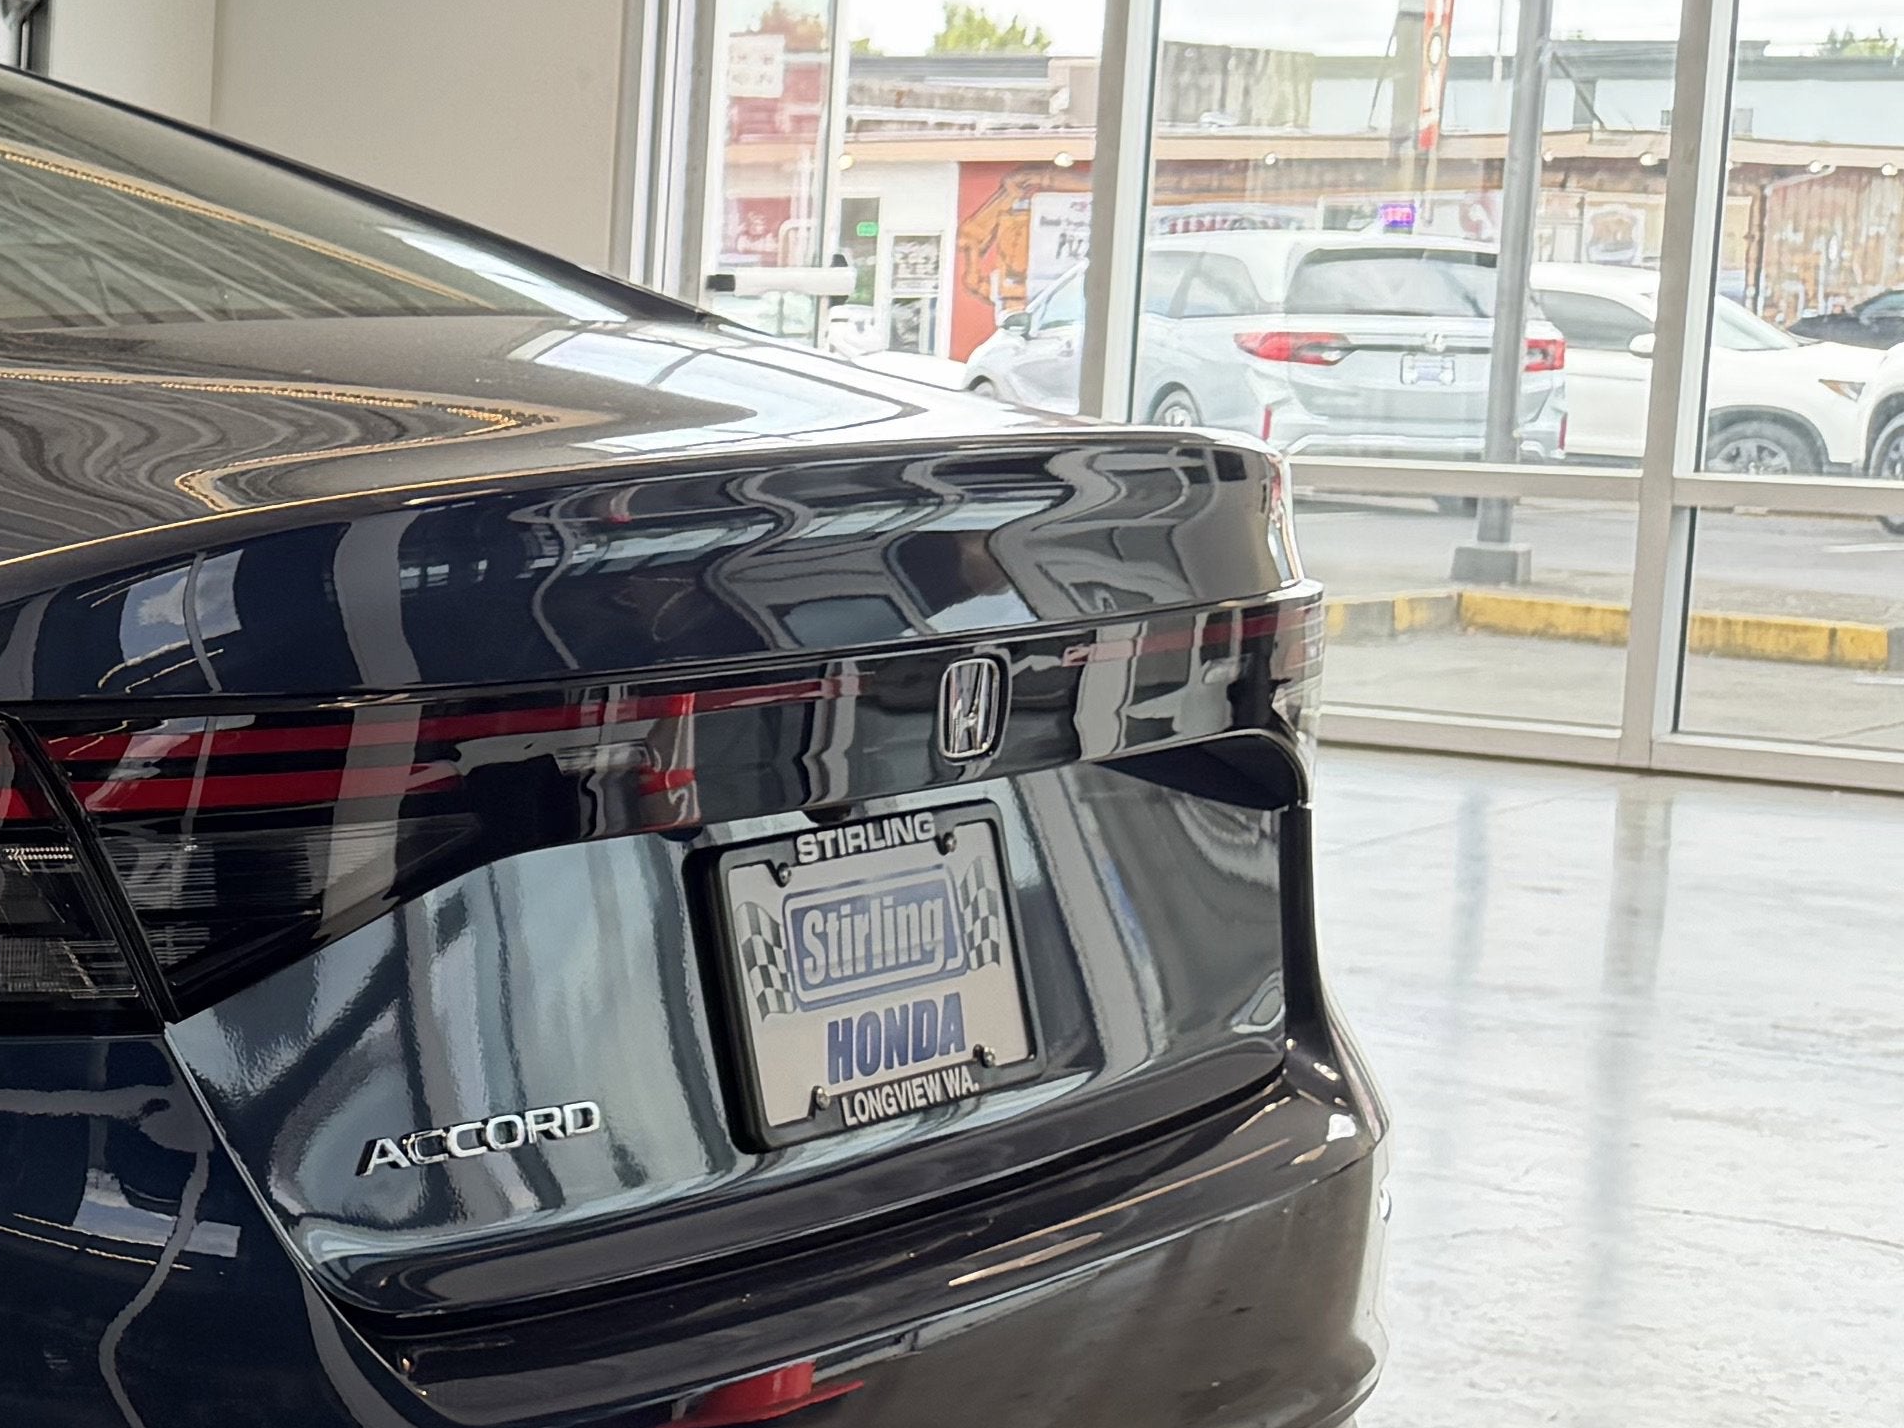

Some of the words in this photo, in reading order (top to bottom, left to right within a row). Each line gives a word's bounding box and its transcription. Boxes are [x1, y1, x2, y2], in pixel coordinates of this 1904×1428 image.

[796, 811, 936, 865] STIRLING
[802, 897, 945, 986] Stirling
[827, 992, 966, 1086] HONDA
[842, 1071, 945, 1126] LONGVIEW
[942, 1066, 980, 1100] WA.
[355, 1099, 601, 1177] ACCORD
